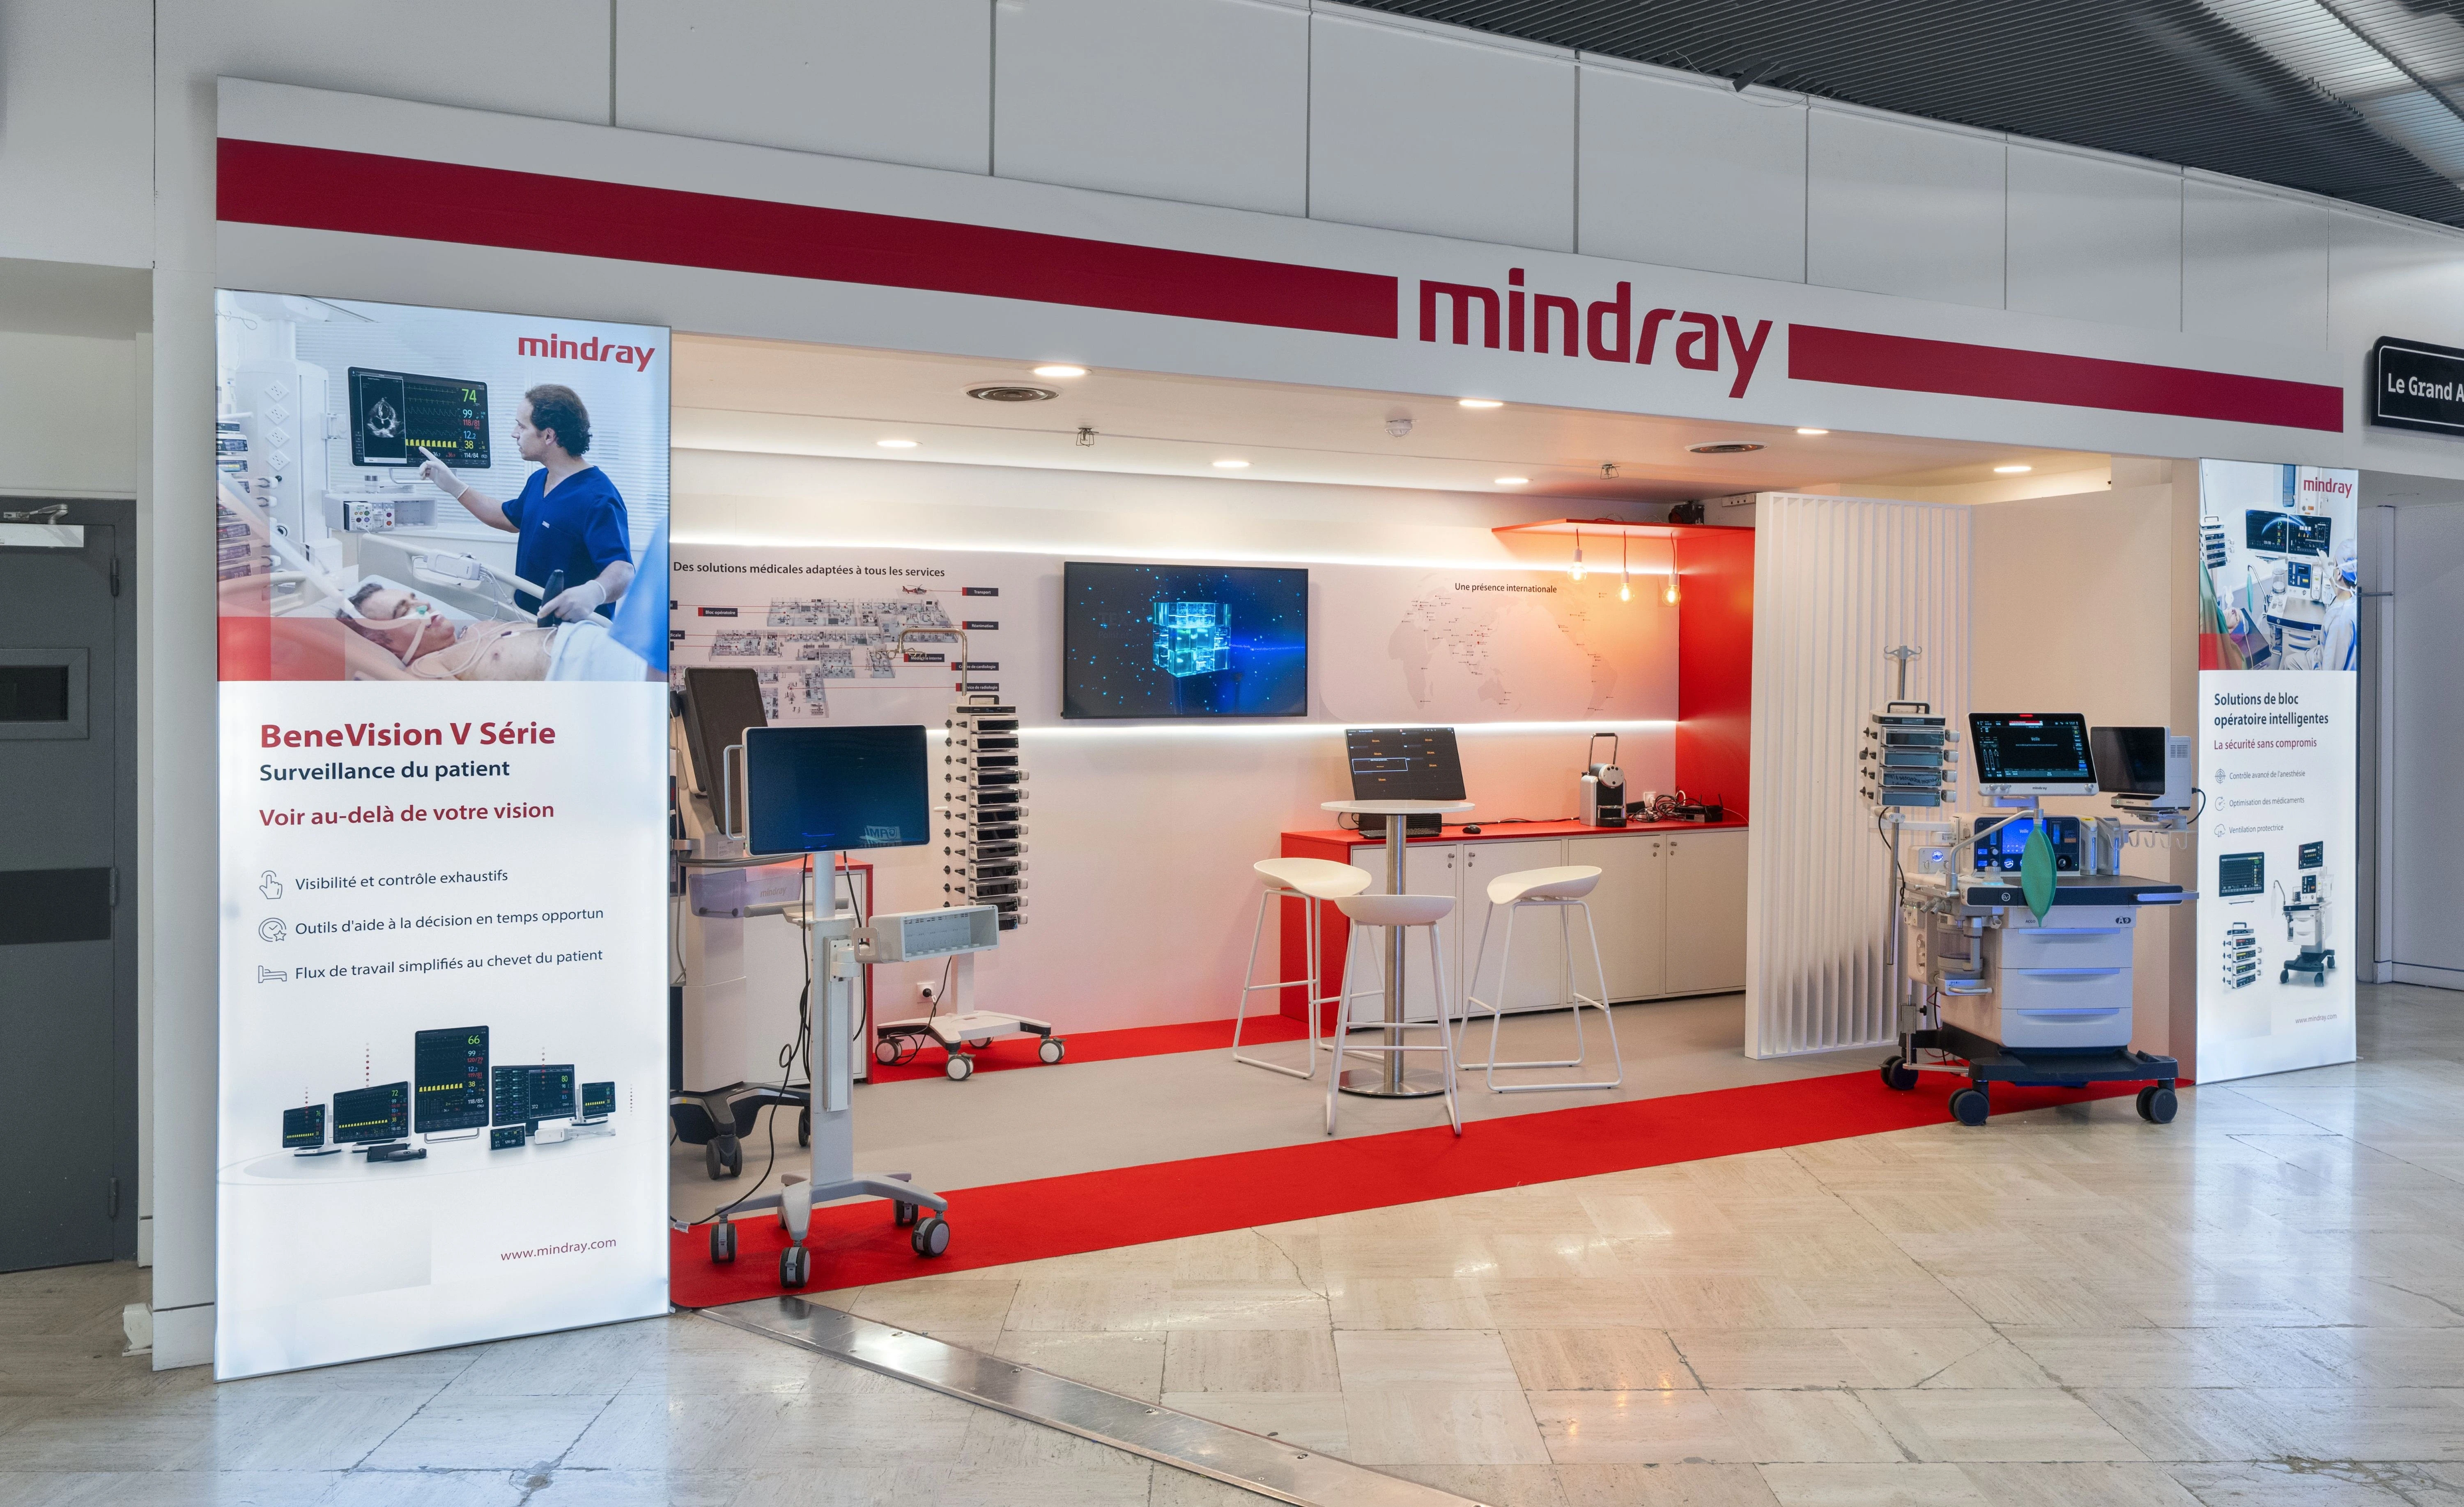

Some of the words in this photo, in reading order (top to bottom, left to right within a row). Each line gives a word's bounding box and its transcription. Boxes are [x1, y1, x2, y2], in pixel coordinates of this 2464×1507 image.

[1420, 268, 1773, 398] mindray
[519, 333, 655, 372] mindray
[2388, 373, 2404, 393] Le
[2409, 377, 2452, 400] Grand
[462, 389, 476, 402] 74
[463, 409, 472, 418] 99
[464, 441, 473, 449] 38
[2304, 477, 2352, 498] mindray
[674, 562, 694, 571] Des
[697, 563, 747, 572] solutions
[750, 564, 803, 573] médicales
[806, 565, 853, 576] adaptées
[856, 565, 862, 575] à
[890, 566, 903, 575] les
[906, 568, 945, 576] services
[1472, 584, 1504, 592] présence
[1507, 584, 1557, 593] internationale
[2215, 693, 2261, 705] Solutions
[2264, 692, 2276, 704] de
[2279, 692, 2298, 704] bloc
[2214, 713, 2266, 728] opératoire
[2270, 712, 2328, 727] intelligentes
[262, 723, 441, 747] BeneVision
[450, 723, 471, 744] V
[480, 721, 555, 744] Série
[2214, 740, 2223, 749] La
[2225, 739, 2255, 749] sécurité
[2276, 738, 2317, 749] compromis
[260, 763, 395, 781] Surveillance
[402, 761, 428, 778] du
[436, 761, 509, 781] patient
[2230, 799, 2261, 808] Optimisation
[260, 809, 305, 826] Voir
[311, 806, 393, 824] au-delà
[401, 805, 427, 821] de
[433, 805, 488, 820] votre
[494, 802, 553, 818] vision
[2257, 825, 2283, 833] protectrice
[296, 876, 356, 889] Visibilité
[361, 877, 374, 887] et
[379, 873, 436, 886] contrôle
[441, 870, 507, 883] exhaustifs
[761, 887, 787, 897] mindray
[296, 921, 337, 934] Outils
[342, 919, 384, 932] d'aide
[389, 918, 395, 929] à
[401, 917, 411, 928] la
[416, 915, 471, 928] décision
[497, 914, 538, 924] temps
[542, 910, 603, 923] opportun
[297, 967, 325, 979] Flux
[330, 965, 347, 976] de
[352, 962, 394, 975] travail
[399, 958, 463, 973] simplifiés
[467, 959, 483, 967] au
[487, 955, 531, 966] chevet
[536, 952, 552, 963] du
[557, 951, 602, 965] patient
[2295, 1014, 2337, 1023] www.mindray.com
[468, 1035, 480, 1044] 66
[501, 1240, 616, 1260] www.mindray.com
